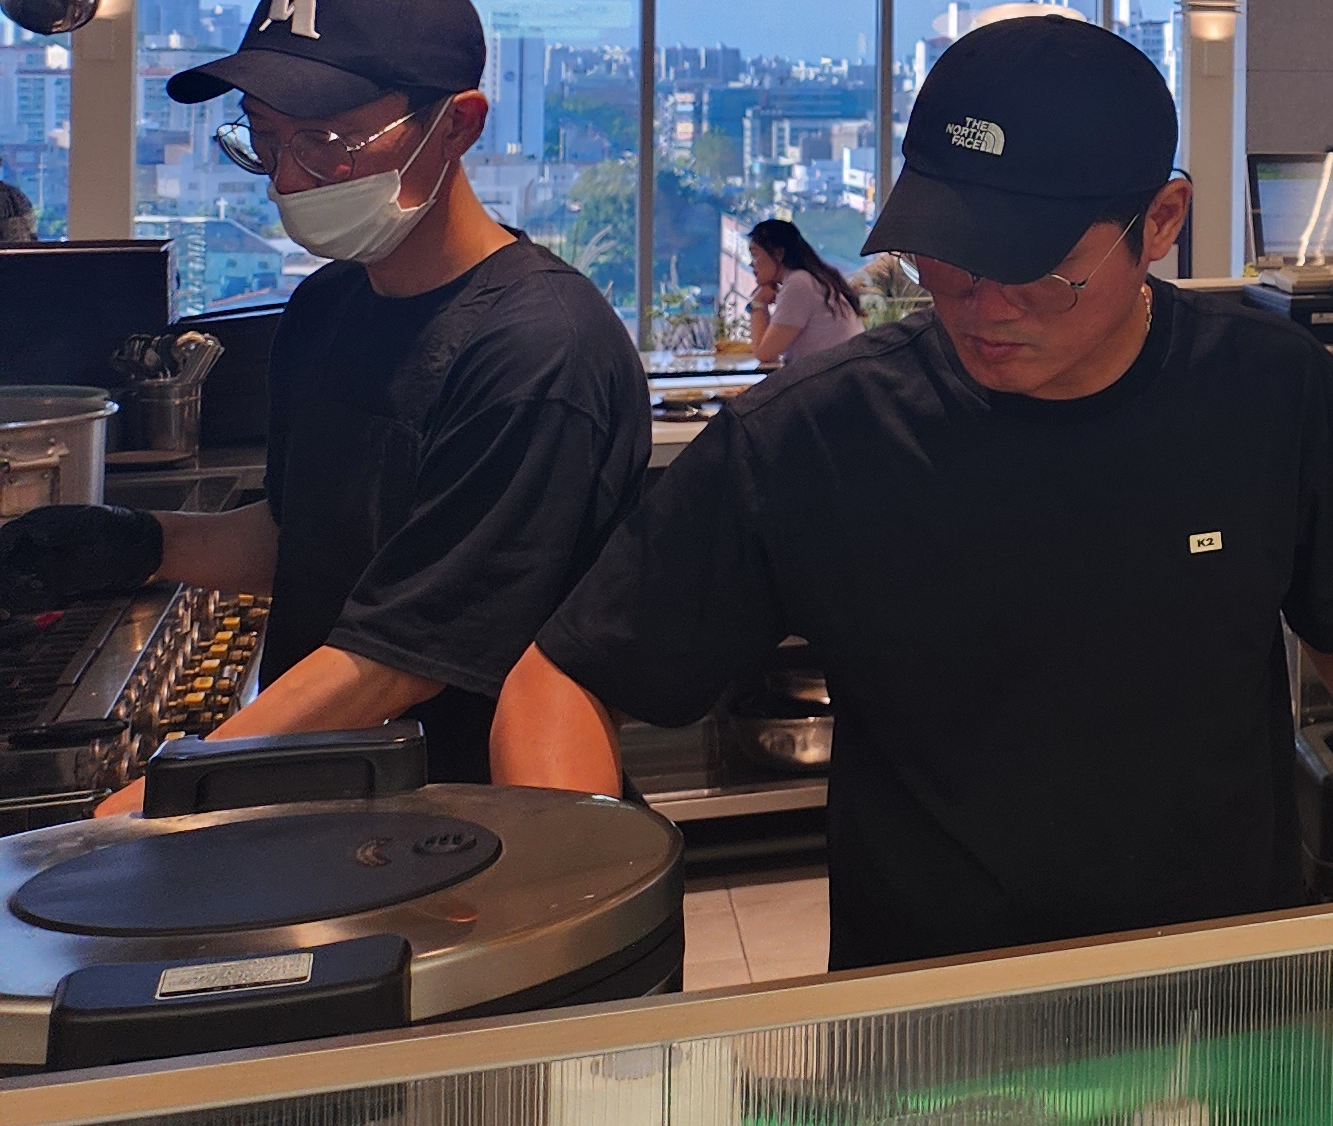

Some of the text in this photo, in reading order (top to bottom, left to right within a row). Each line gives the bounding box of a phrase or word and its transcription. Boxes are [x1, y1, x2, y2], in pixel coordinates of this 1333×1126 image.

[965, 116, 990, 131] THE
[945, 123, 986, 140] NORTH
[951, 135, 982, 150] FACE
[1197, 537, 1215, 548] K2
